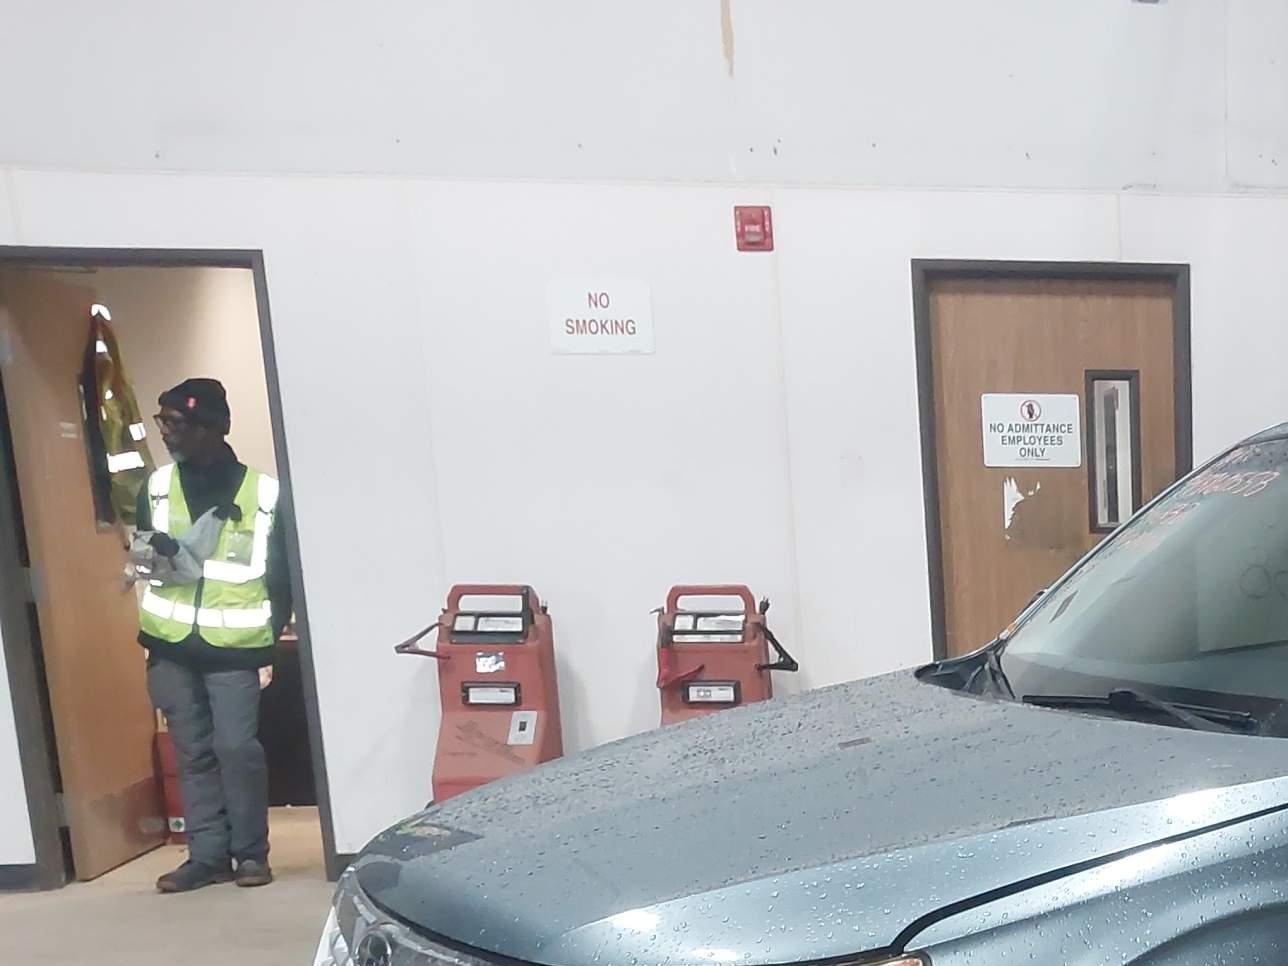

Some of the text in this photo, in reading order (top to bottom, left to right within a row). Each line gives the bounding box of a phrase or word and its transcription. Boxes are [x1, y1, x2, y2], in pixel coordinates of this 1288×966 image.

[588, 292, 610, 309] NO
[565, 318, 637, 336] SMOKING
[989, 422, 1074, 434] NO ADMITTANCE
[1001, 434, 1064, 446] EMPLOYEES
[1019, 446, 1046, 458] ONLY
